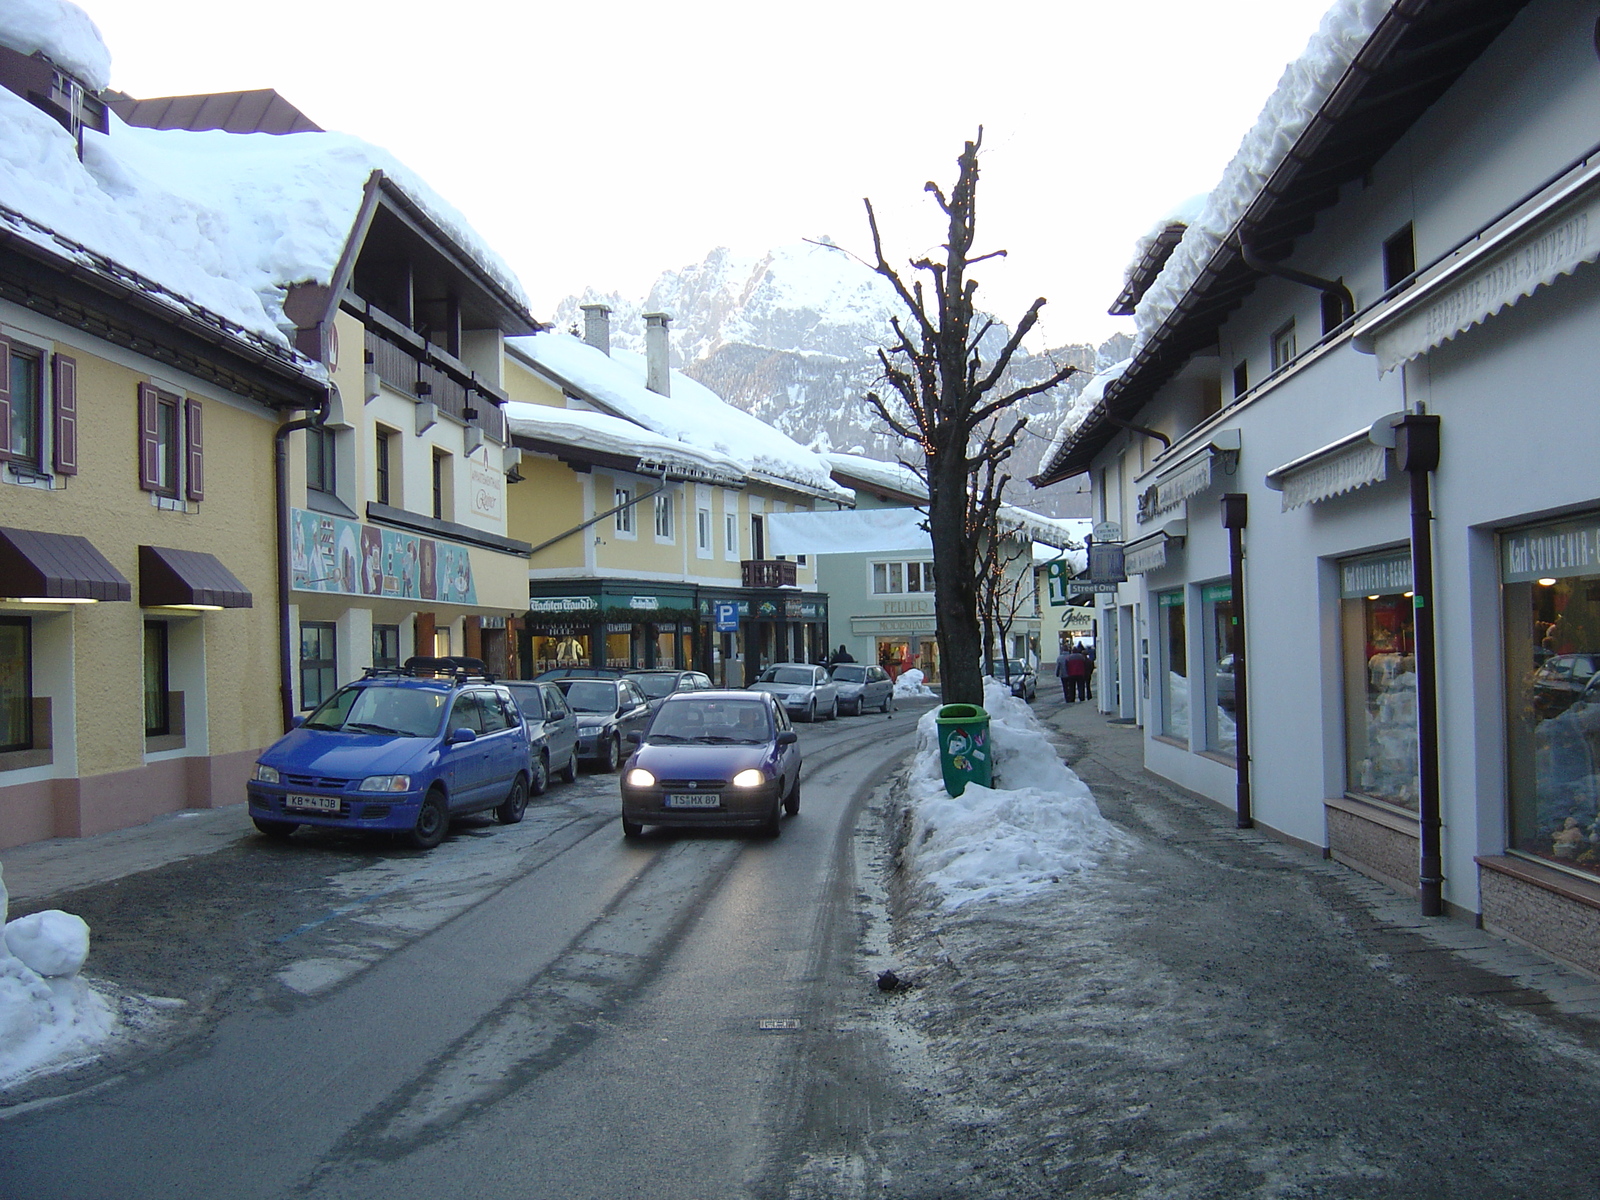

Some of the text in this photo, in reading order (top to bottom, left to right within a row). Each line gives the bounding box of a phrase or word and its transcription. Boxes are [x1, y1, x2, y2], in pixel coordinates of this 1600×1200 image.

[1508, 538, 1529, 574] Karl
[1072, 584, 1116, 592] Street One
[883, 600, 929, 613] FELLER
[719, 605, 734, 622] P
[291, 796, 303, 806] KB
[673, 795, 686, 804] TS
[705, 795, 717, 804] 89
